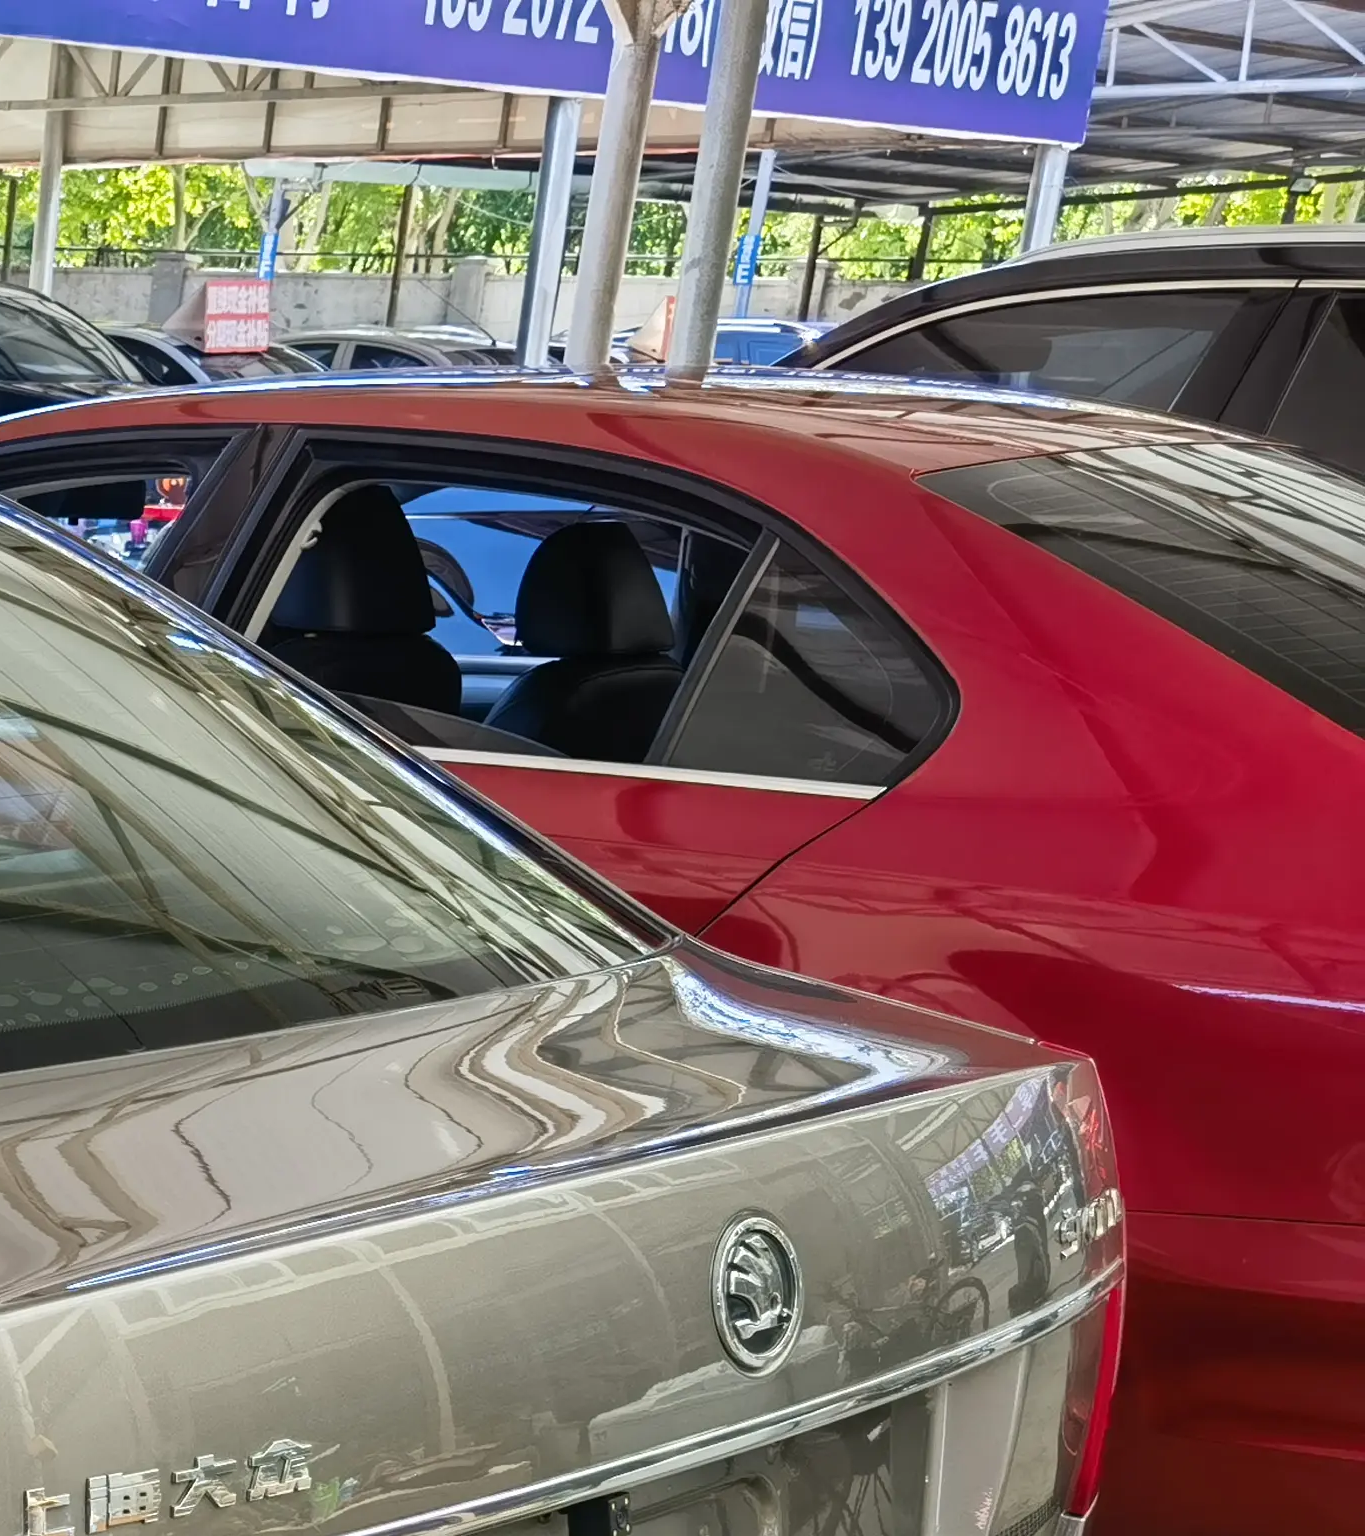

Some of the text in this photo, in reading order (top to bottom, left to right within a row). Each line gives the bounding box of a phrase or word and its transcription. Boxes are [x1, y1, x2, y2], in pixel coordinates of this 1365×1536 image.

[850, 0, 911, 82] 139
[910, 0, 998, 91] 2005
[996, 5, 1077, 100] 8613
